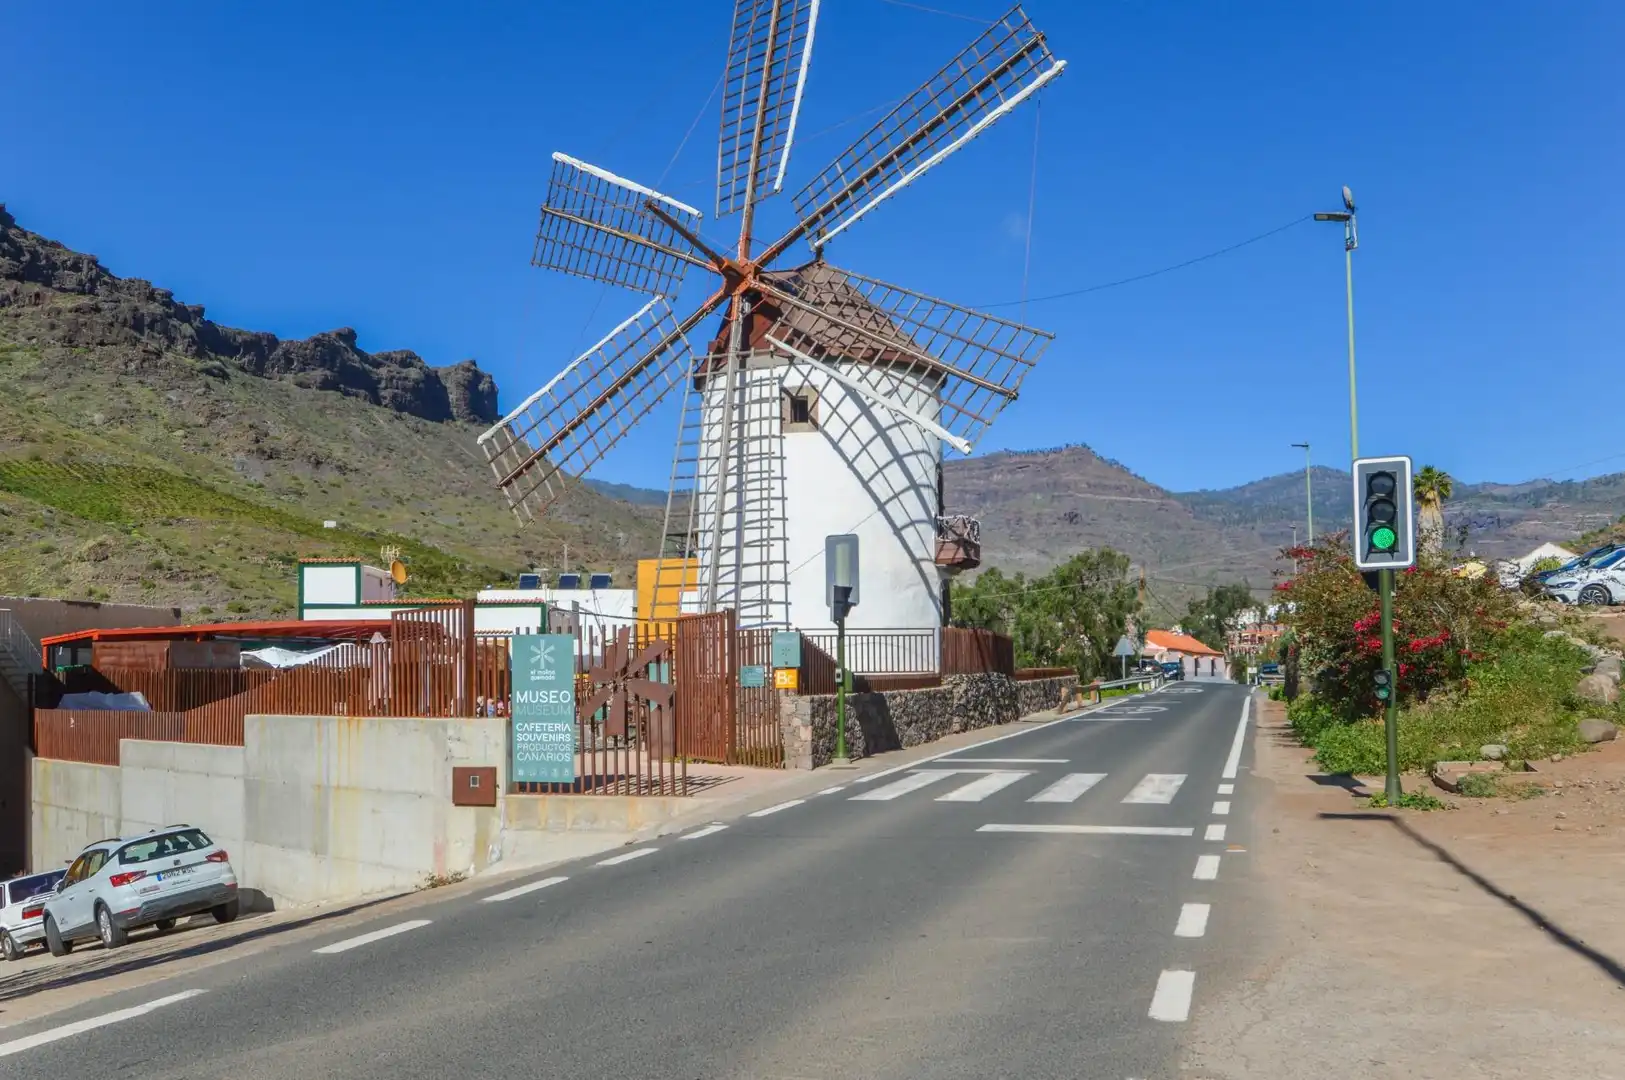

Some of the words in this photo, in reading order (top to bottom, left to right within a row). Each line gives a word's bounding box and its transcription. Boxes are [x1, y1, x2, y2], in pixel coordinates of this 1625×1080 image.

[516, 690, 571, 703] MUSEO
[516, 704, 571, 715] MUSEUM
[516, 733, 571, 742] SOUVENIRS
[517, 743, 571, 752] PRODUCTOS
[517, 752, 571, 762] CANARIOS
